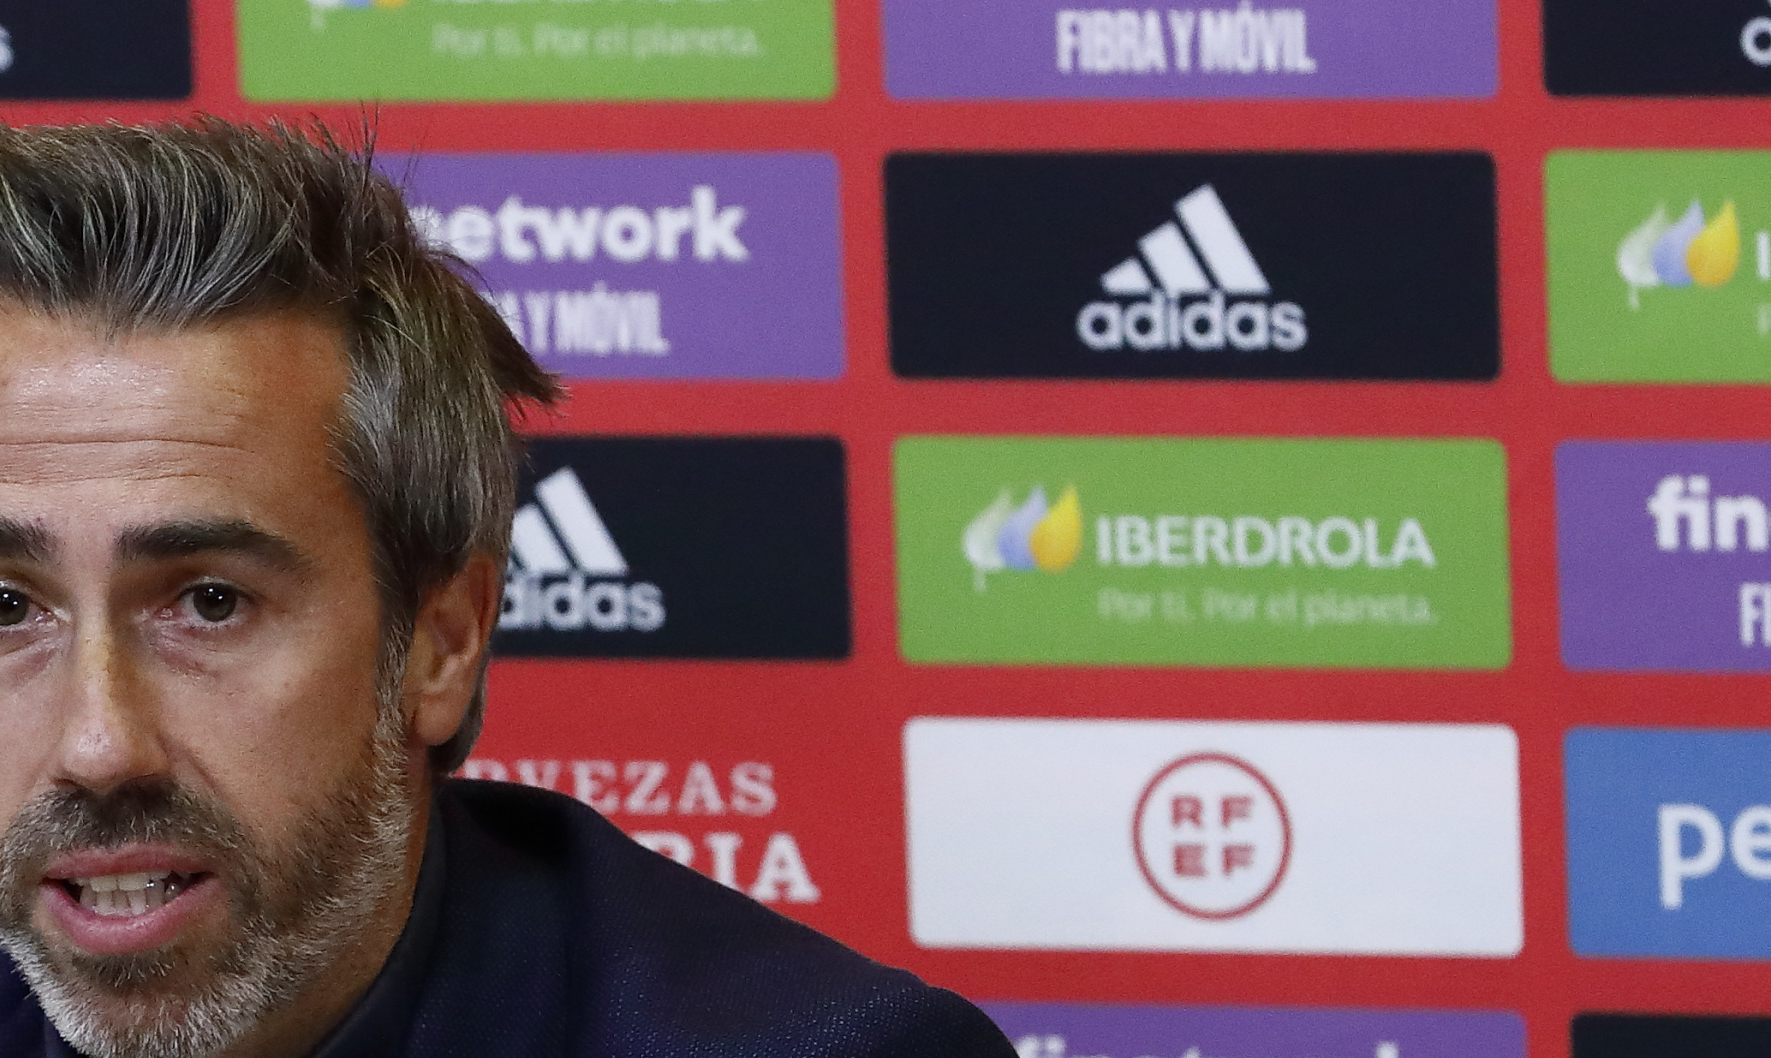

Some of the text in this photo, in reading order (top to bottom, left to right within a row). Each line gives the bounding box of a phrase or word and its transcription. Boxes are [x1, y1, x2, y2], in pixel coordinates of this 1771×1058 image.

[1057, 0, 1316, 74] FIBRA Y MÓVIL
[406, 185, 749, 261] network
[524, 290, 550, 353] Y
[553, 279, 670, 356] MÓVIL
[1076, 291, 1308, 351] adidas
[1095, 514, 1436, 569] IBERDROLA
[498, 574, 666, 631] didas
[1097, 588, 1152, 617] Por
[1205, 589, 1258, 620] Por
[1304, 591, 1437, 628] planeta.
[464, 758, 779, 816] VEZAS
